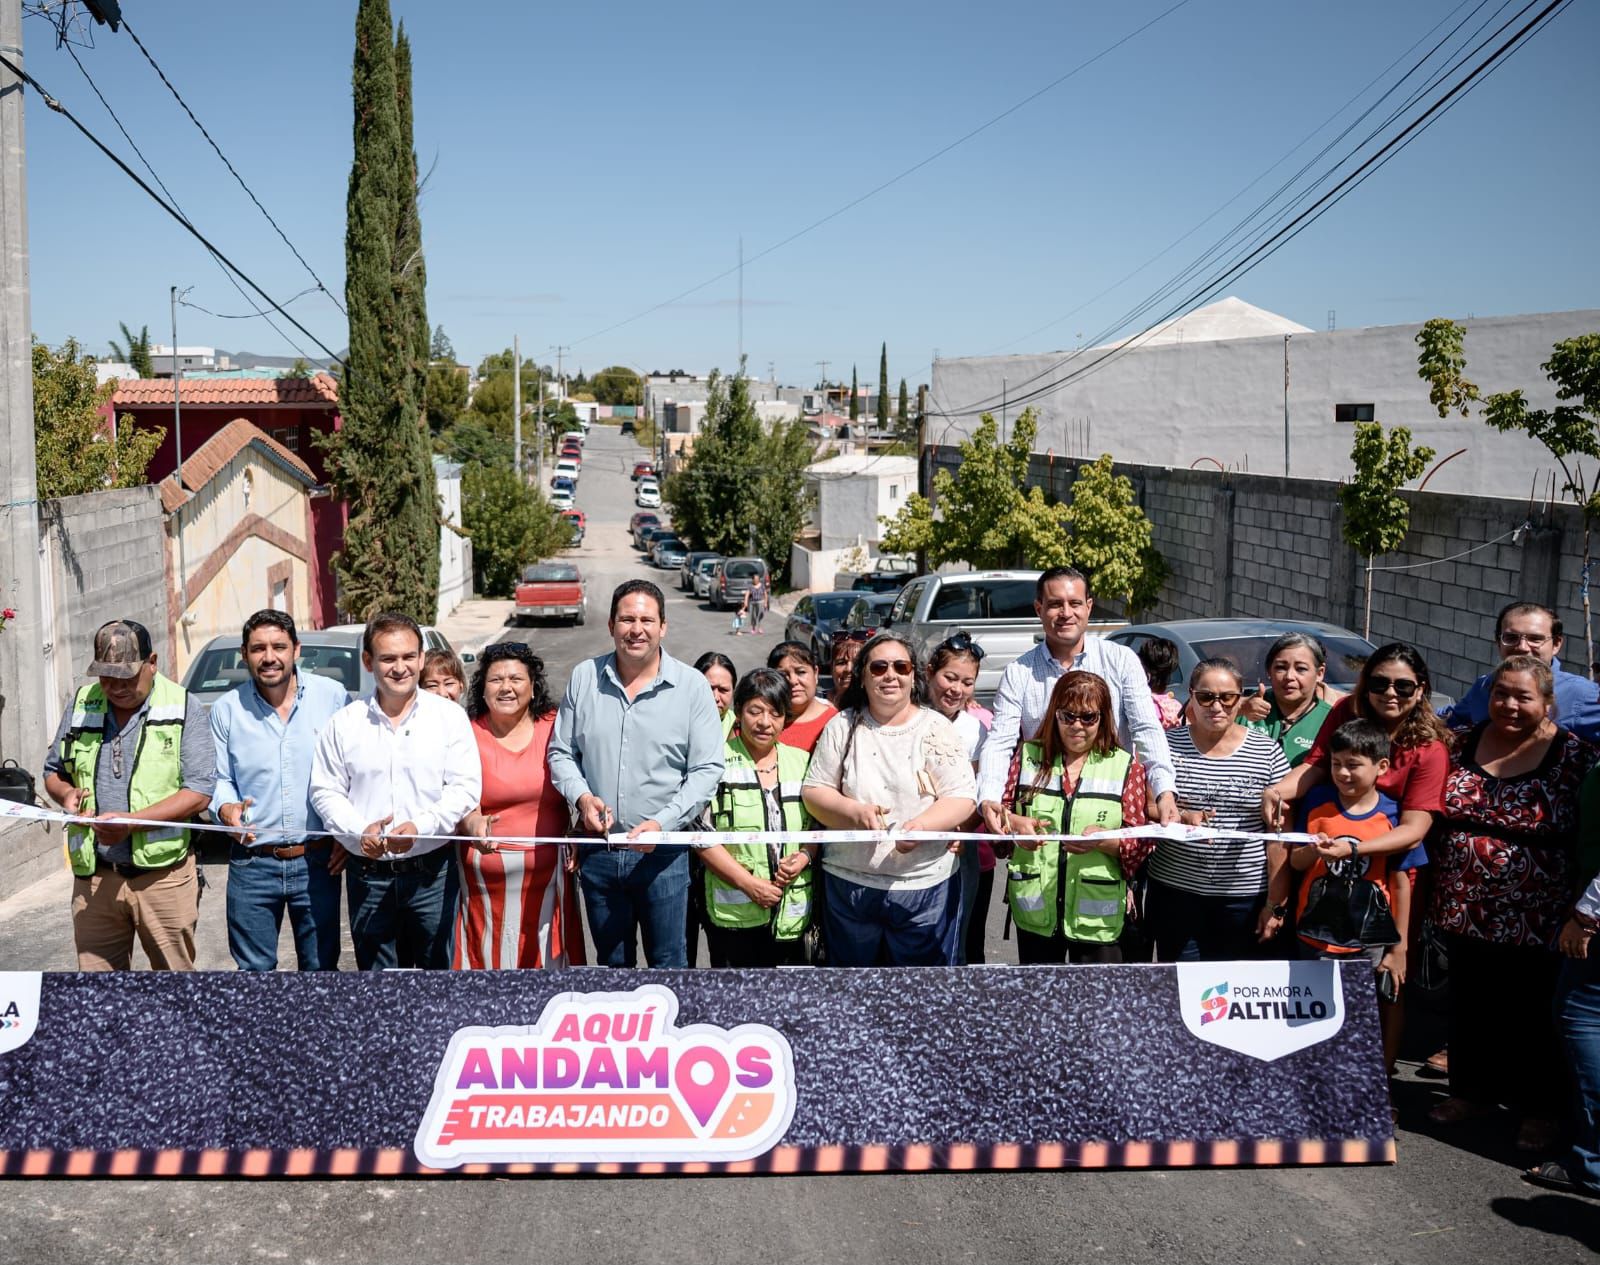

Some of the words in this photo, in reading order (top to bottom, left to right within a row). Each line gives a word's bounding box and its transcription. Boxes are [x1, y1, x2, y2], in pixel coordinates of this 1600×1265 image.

[1233, 986, 1260, 998] POR
[1263, 986, 1301, 998] AMOR
[1303, 985, 1313, 998] A
[551, 1006, 657, 1043] AQUÍ
[456, 1046, 774, 1092] ANDAMOS
[468, 1105, 670, 1128] TRABAJANDO
